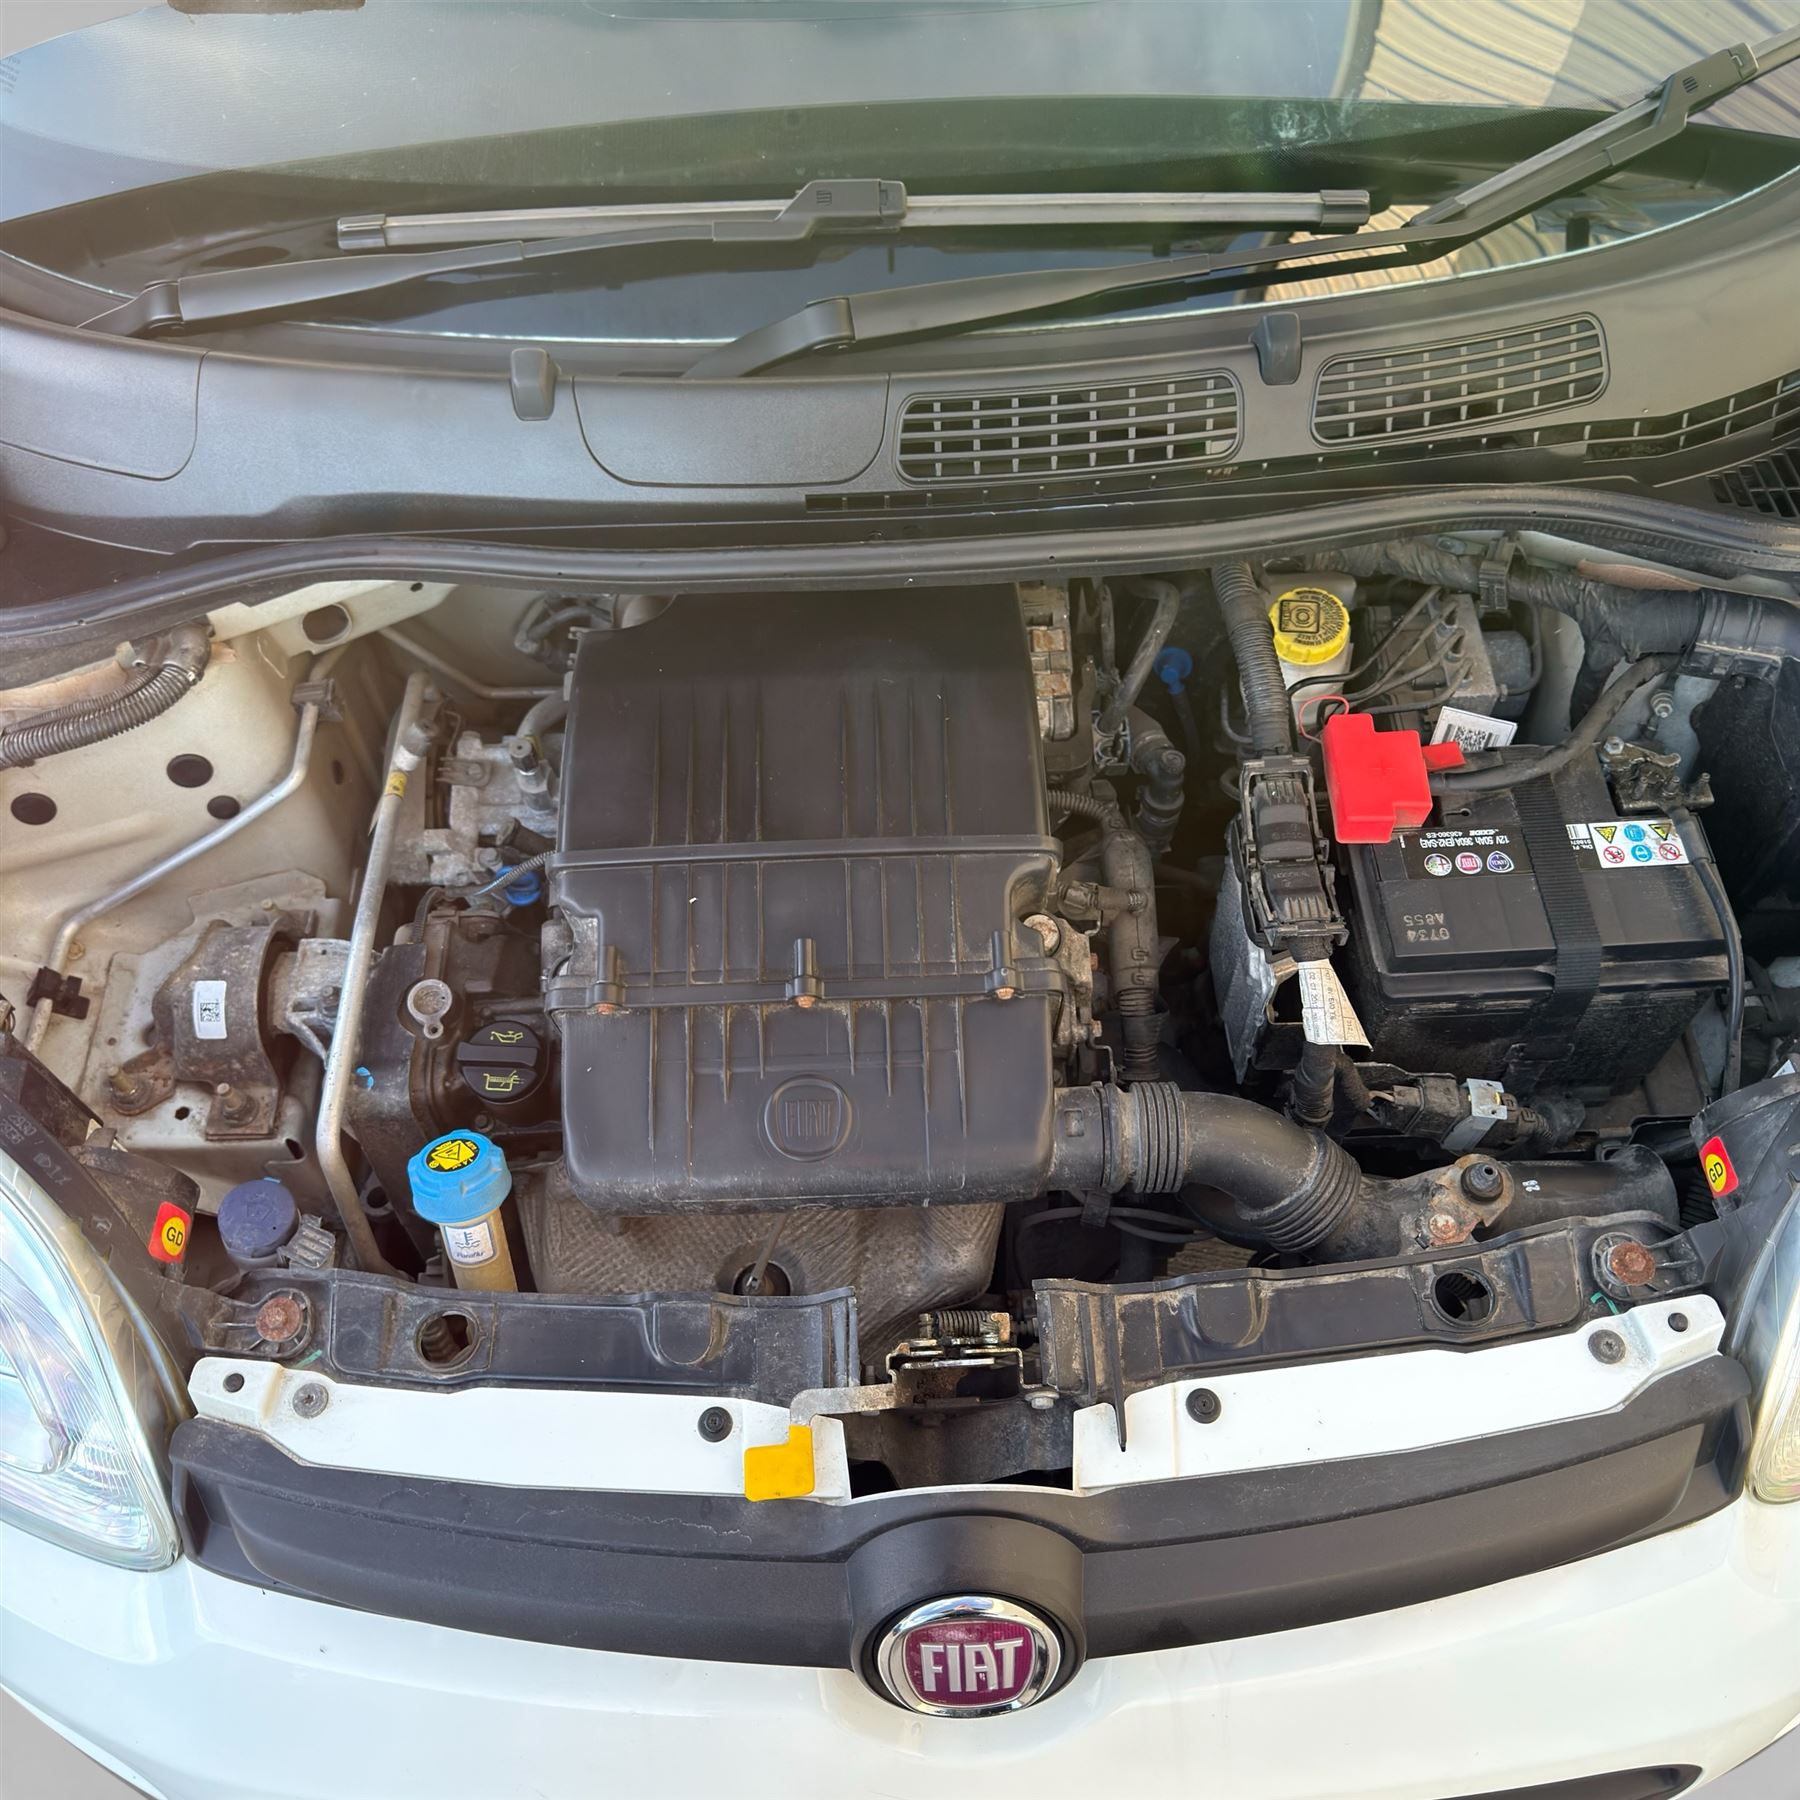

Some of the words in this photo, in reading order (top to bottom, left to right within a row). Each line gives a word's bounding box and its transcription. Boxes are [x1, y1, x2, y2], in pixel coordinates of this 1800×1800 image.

[1455, 837, 1474, 847] 360A
[1475, 836, 1494, 846] 50Ah
[1496, 835, 1510, 845] 12V
[1461, 858, 1477, 868] FIAT
[1403, 913, 1445, 927] A855
[784, 1100, 834, 1137] FIAT
[1708, 1161, 1724, 1183] GD
[166, 1226, 184, 1247] GD
[919, 1638, 1024, 1693] FIAT
